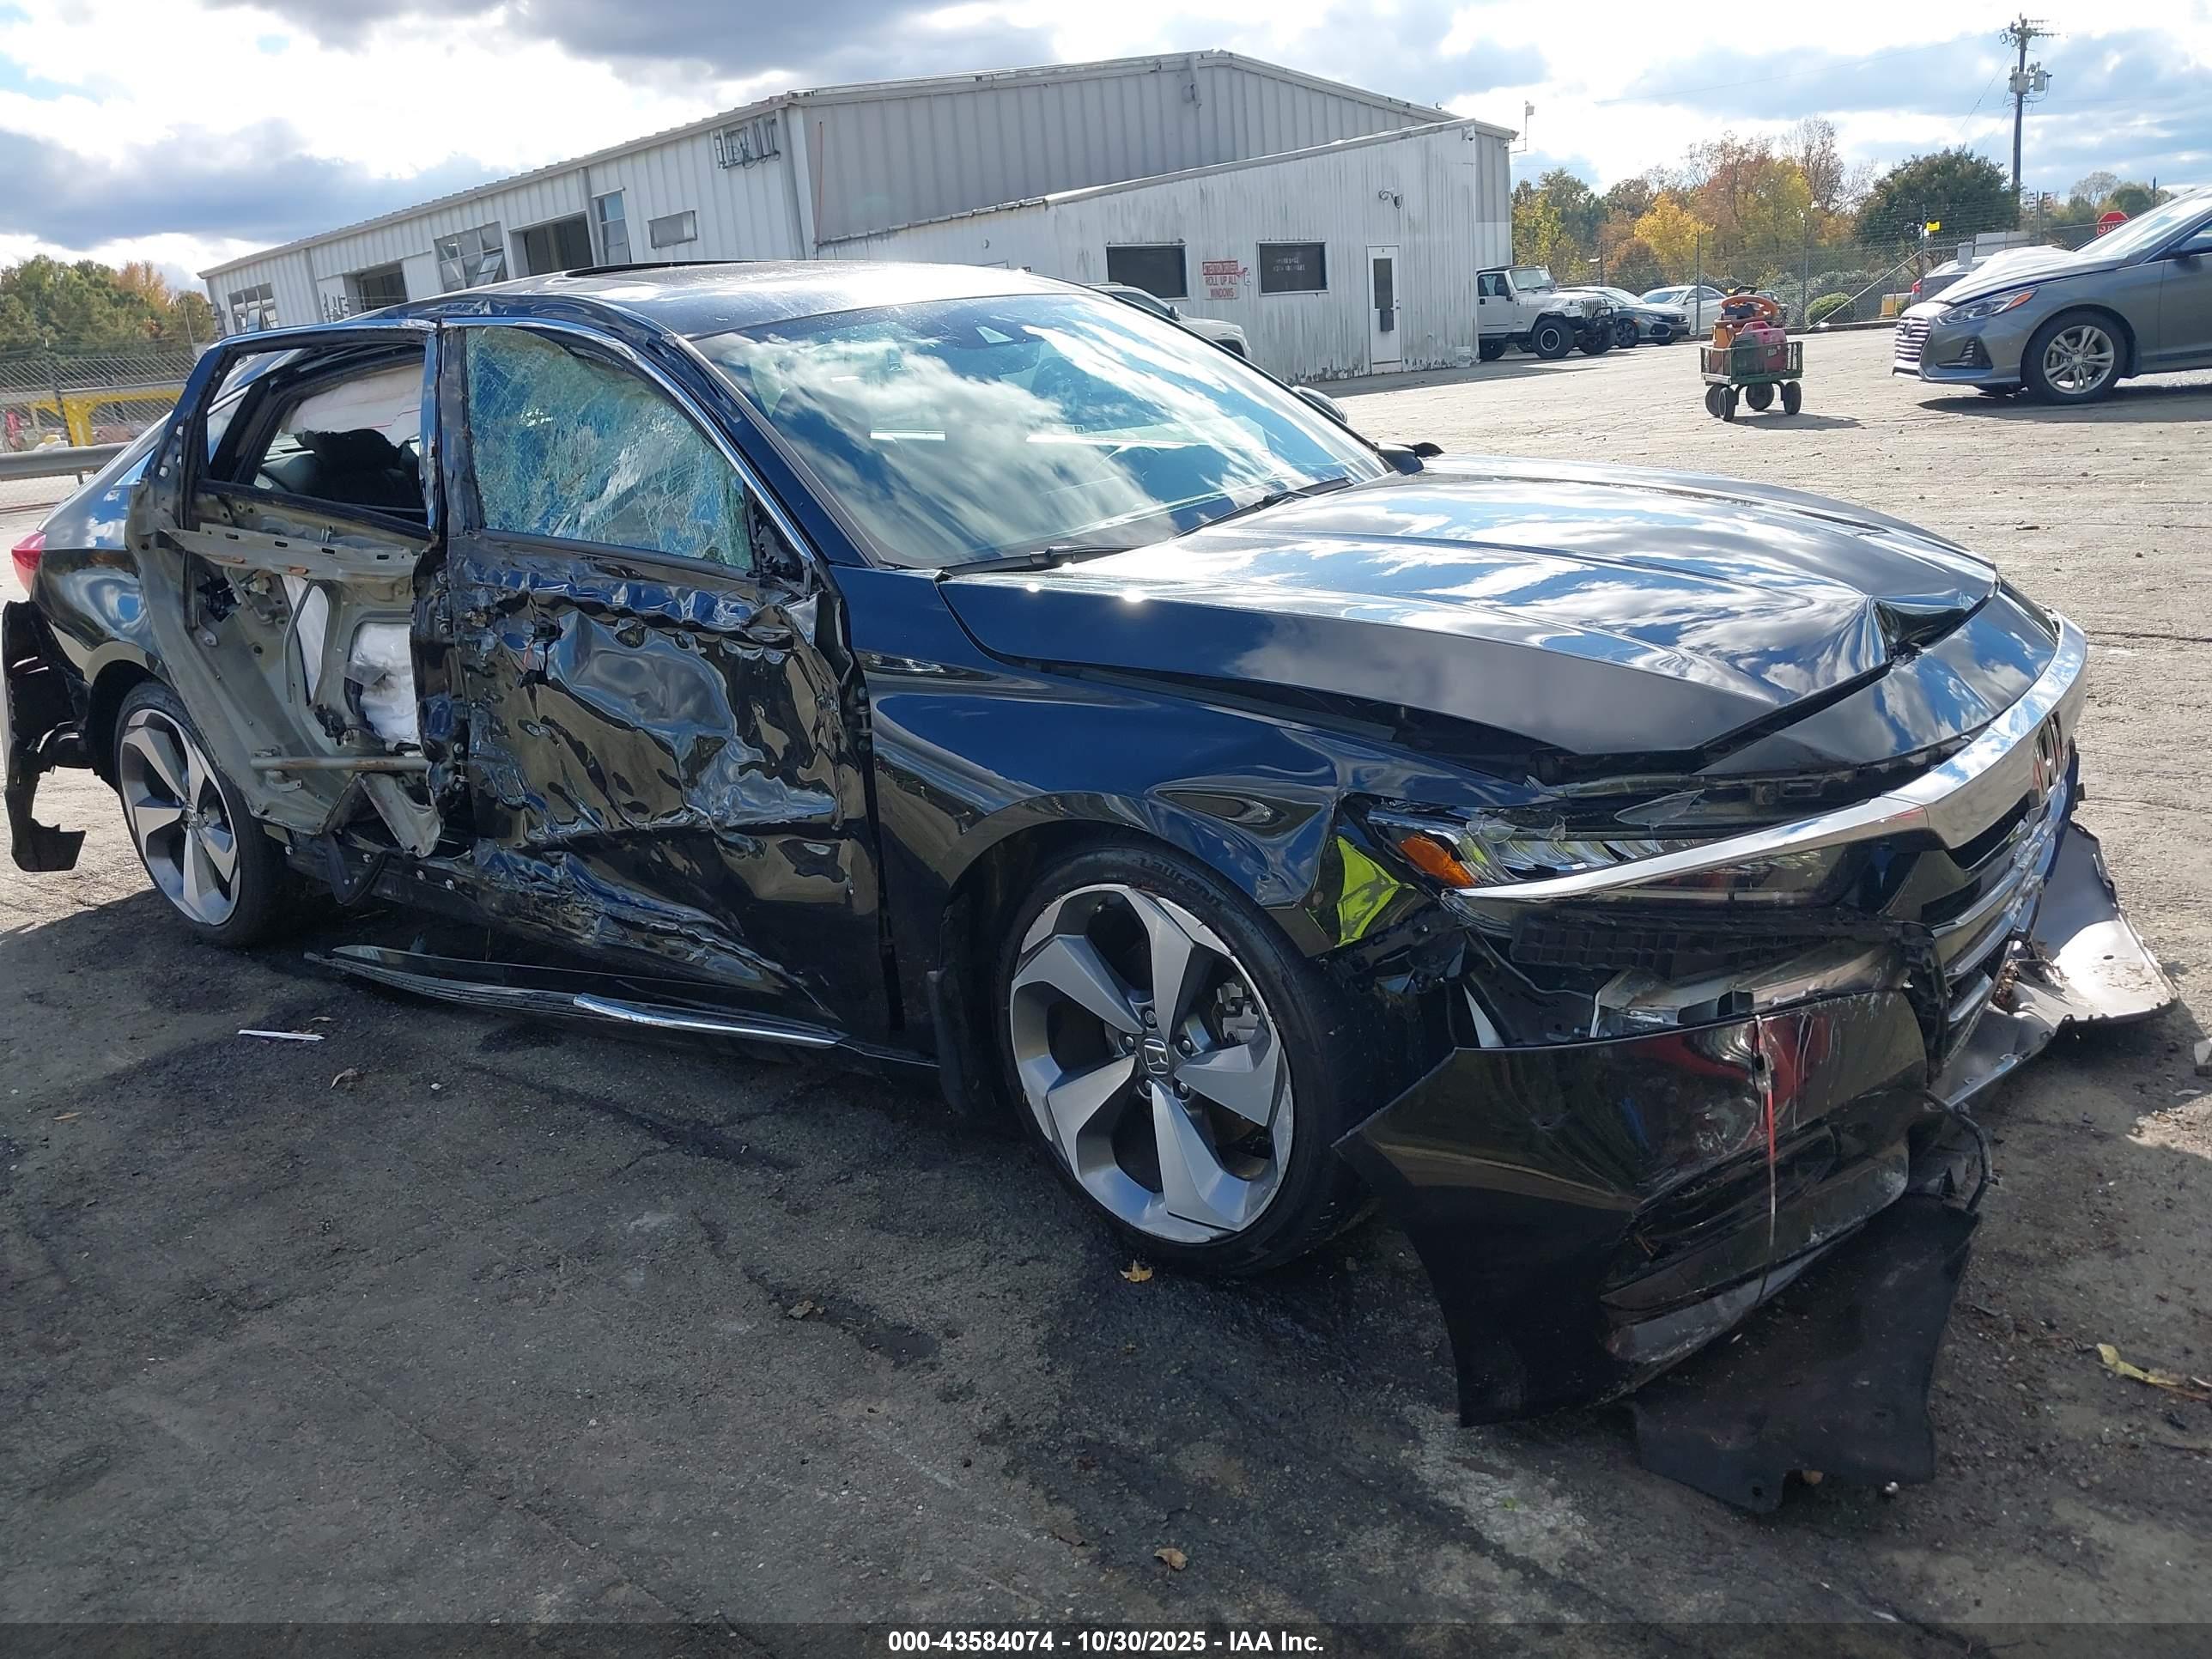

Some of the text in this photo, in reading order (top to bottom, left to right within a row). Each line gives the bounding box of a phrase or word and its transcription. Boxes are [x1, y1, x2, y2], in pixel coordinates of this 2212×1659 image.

[1205, 275, 1237, 286] ROLL UP ALL
[1210, 288, 1235, 298] WINDOWS
